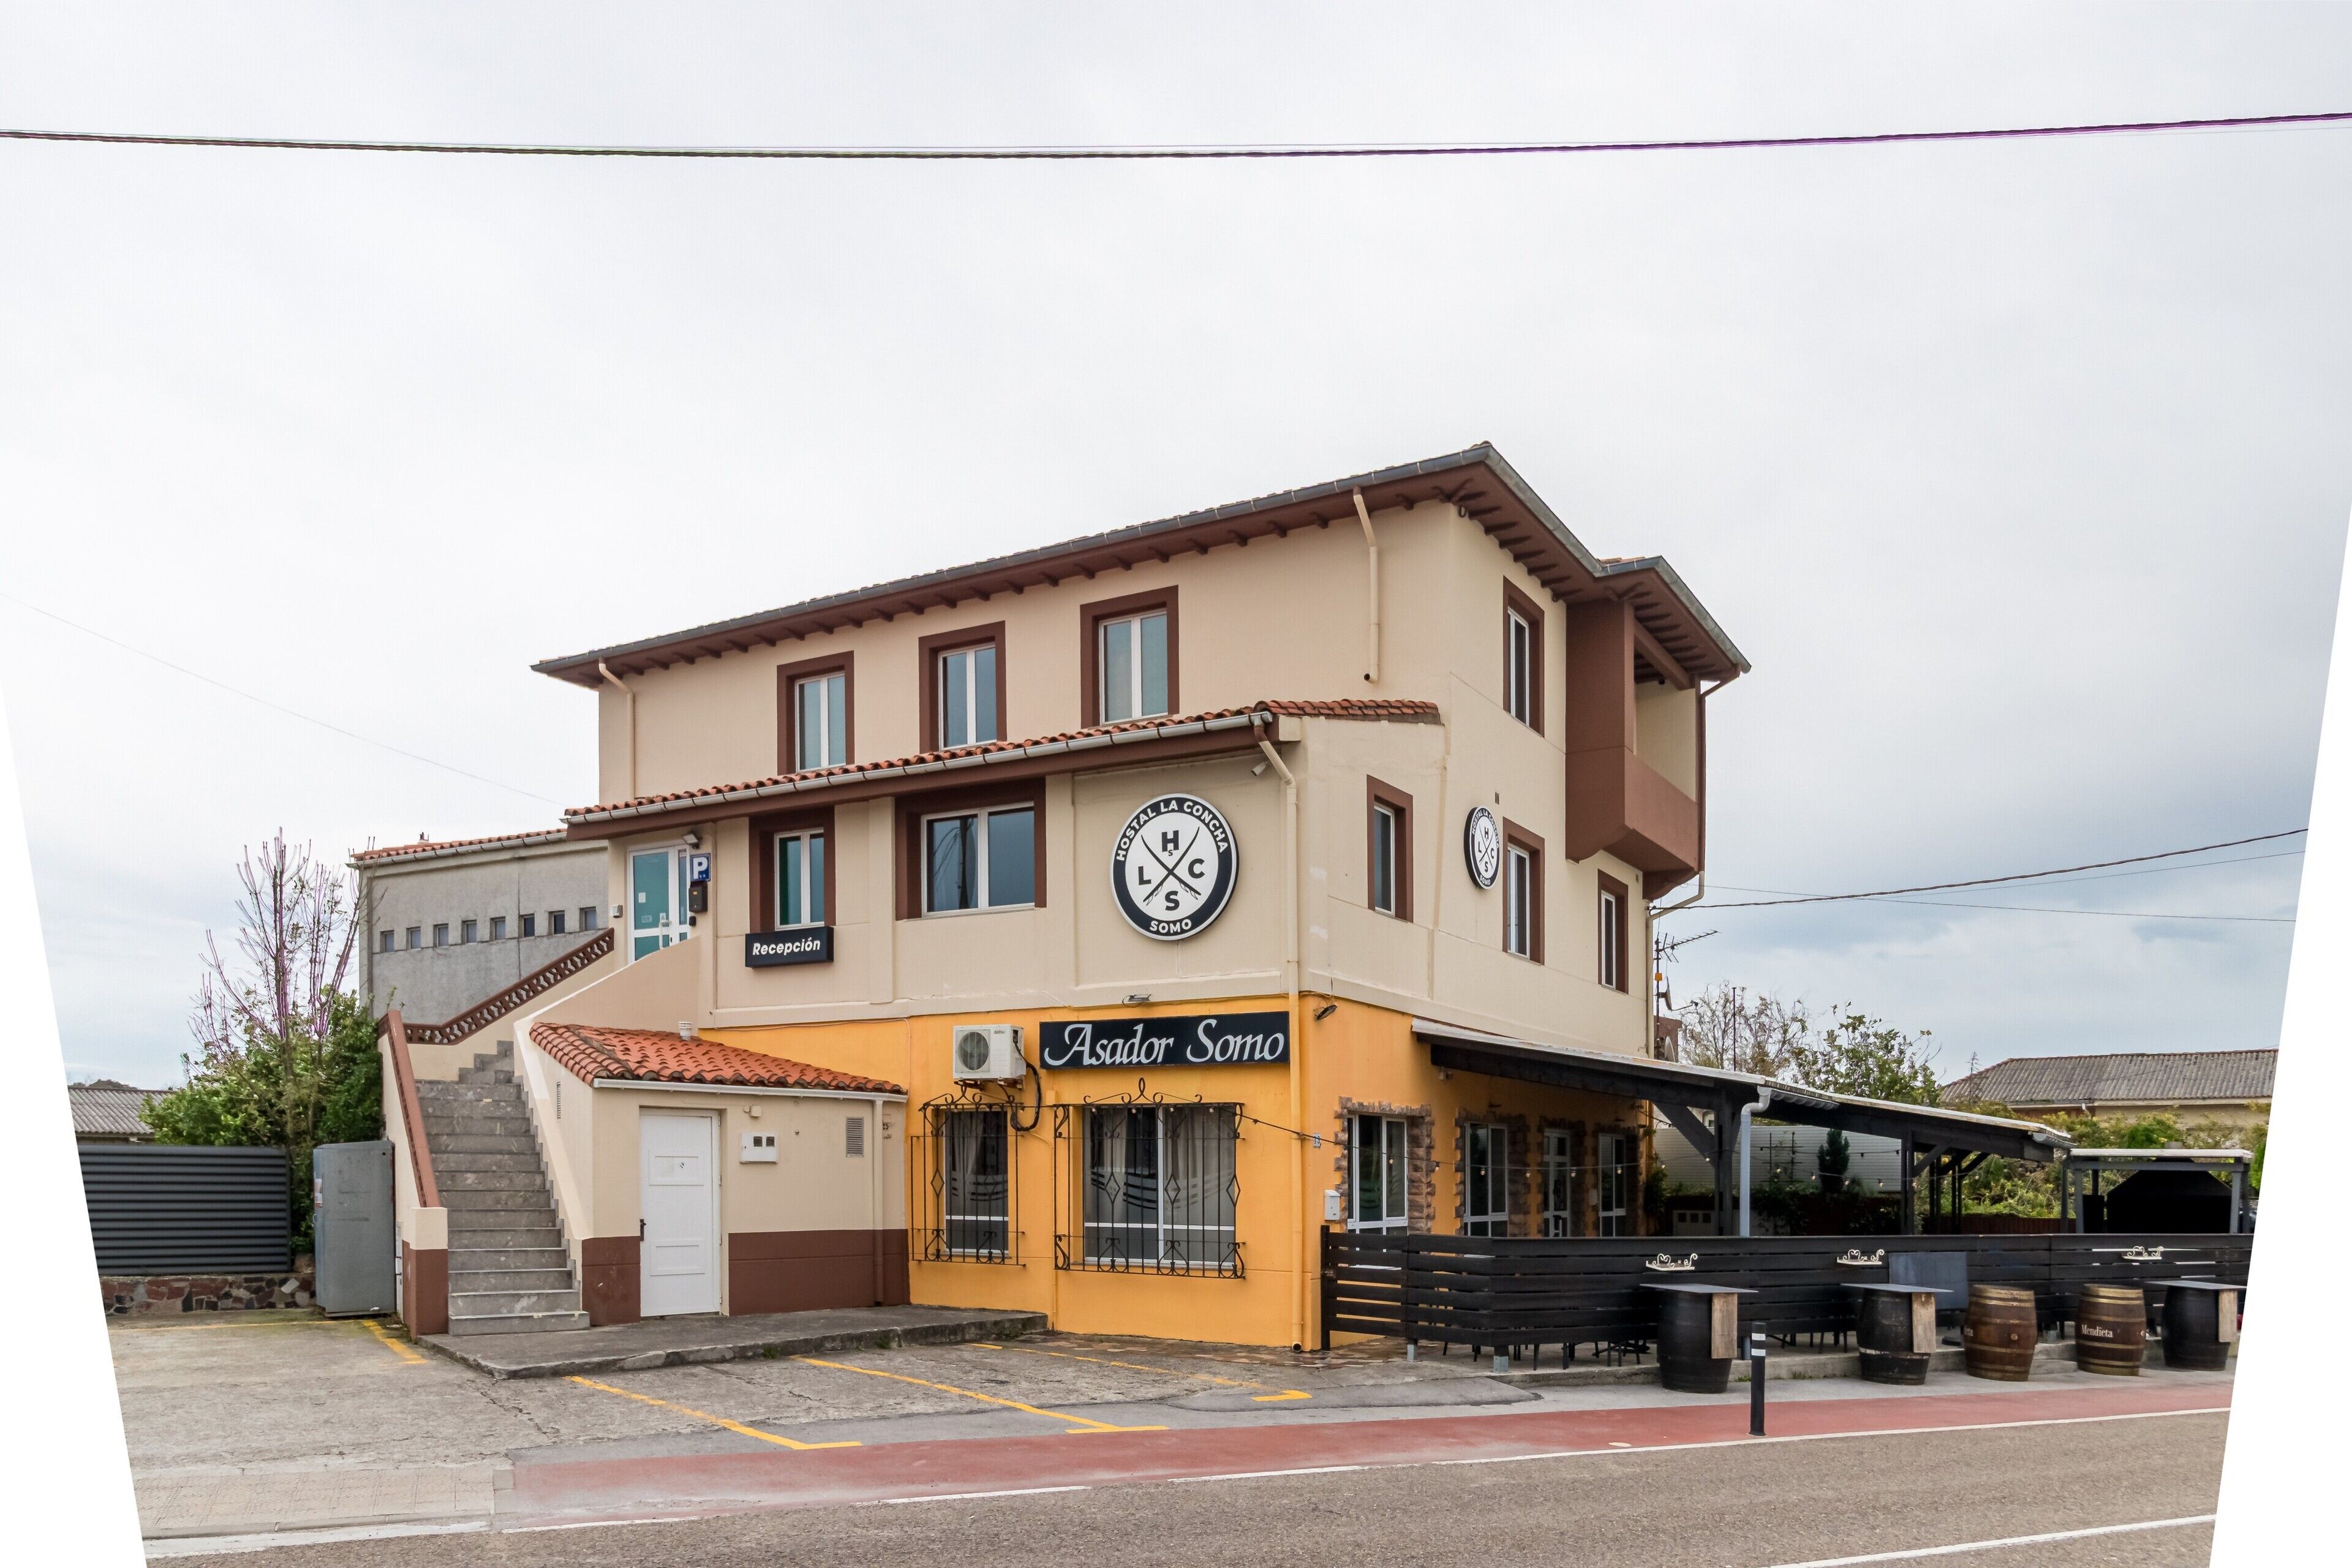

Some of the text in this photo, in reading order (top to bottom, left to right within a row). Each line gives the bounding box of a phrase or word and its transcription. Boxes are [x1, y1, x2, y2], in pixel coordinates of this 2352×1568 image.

[1116, 800, 1229, 861] HOSTAL LA CONCHA
[1161, 830, 1179, 852] H
[693, 856, 708, 880] P
[1138, 858, 1205, 885] L C
[1165, 891, 1180, 911] S
[1150, 919, 1192, 933] SOMO
[752, 937, 821, 956] Recepción
[1044, 1019, 1284, 1066] Asador Somo
[2081, 1324, 2114, 1338] Mendieta
